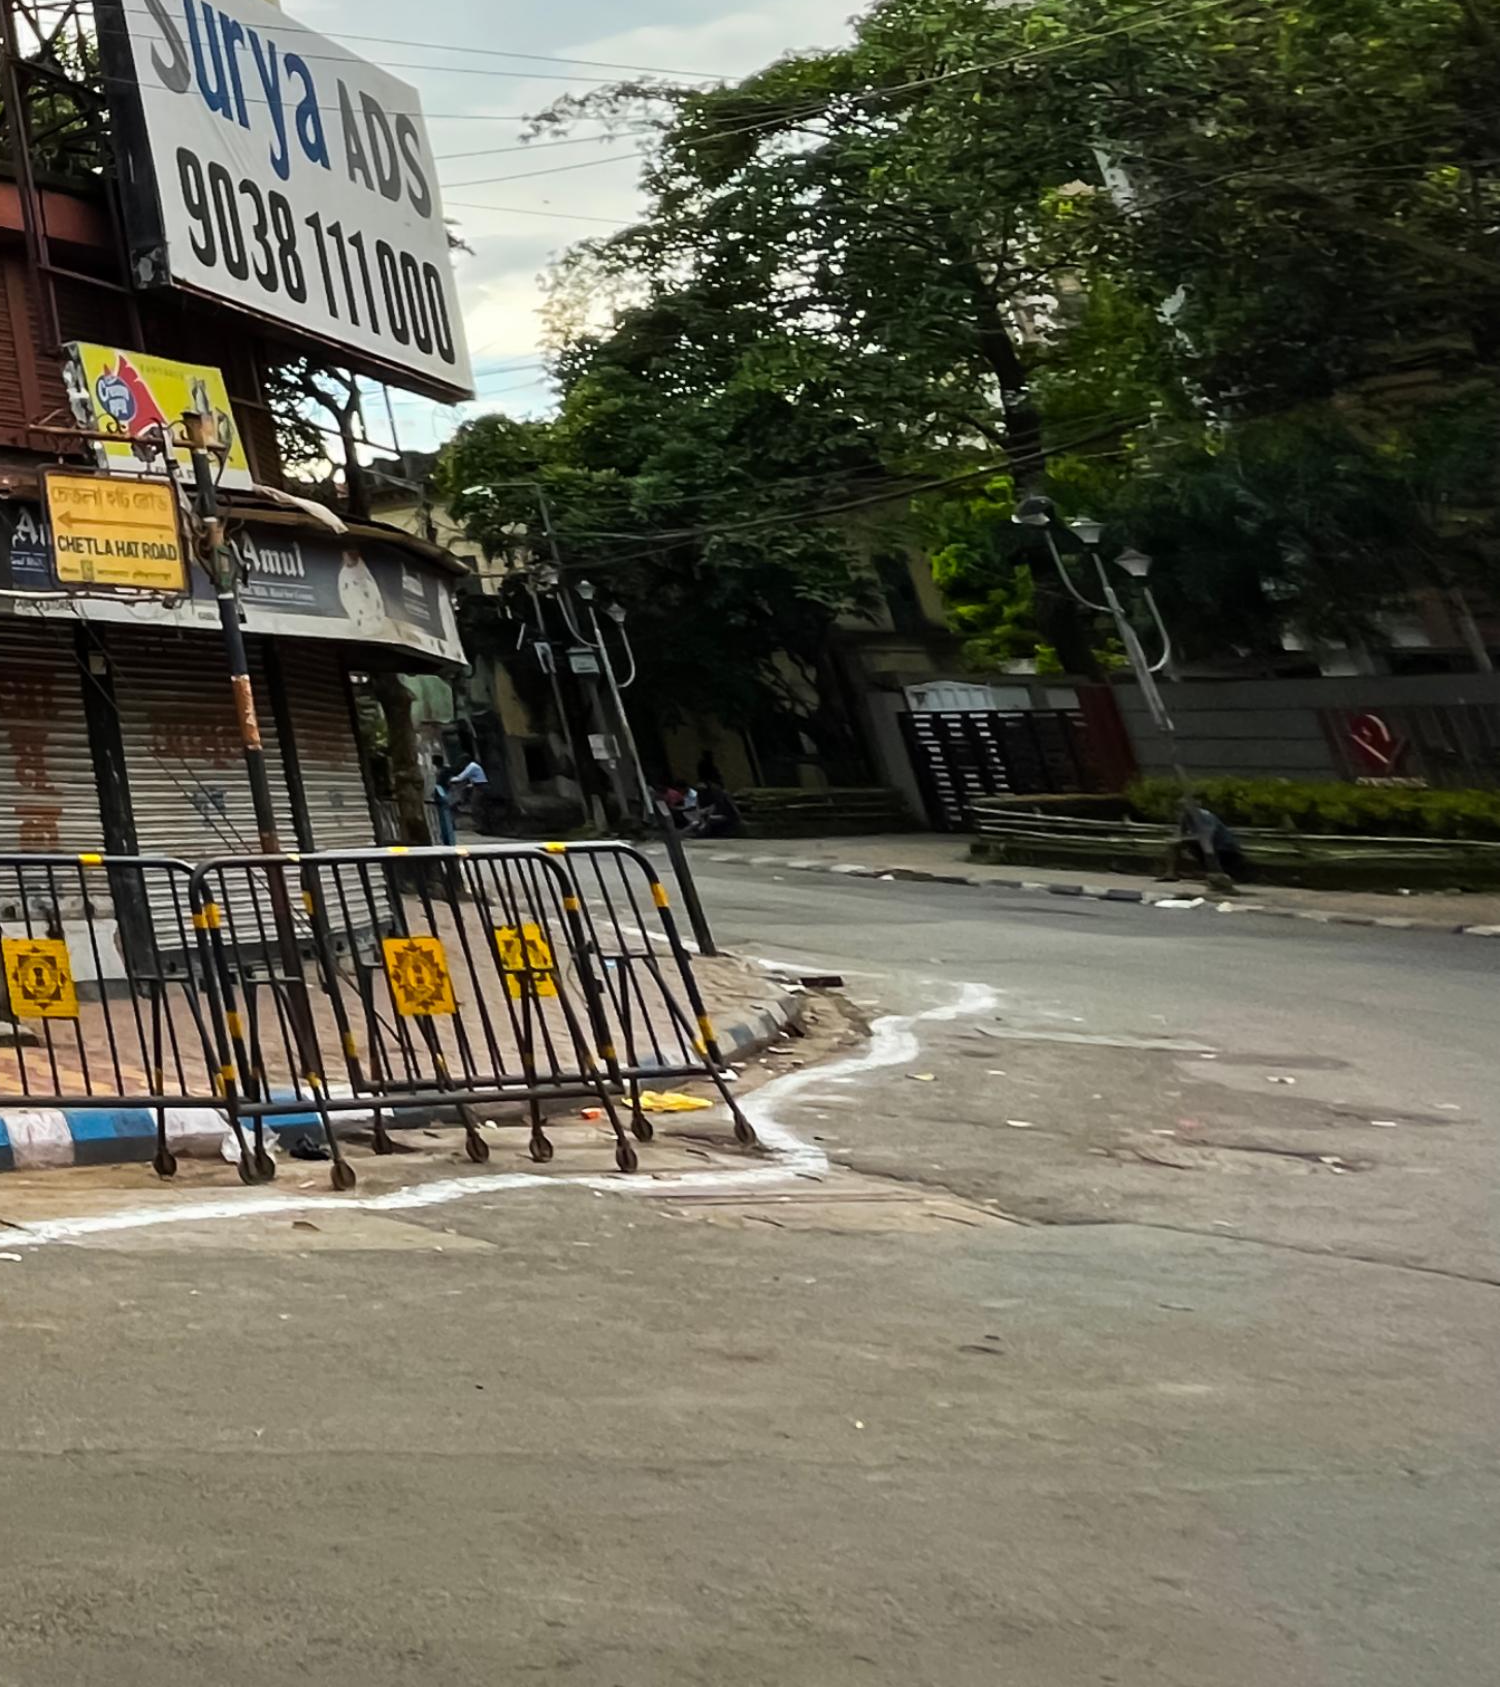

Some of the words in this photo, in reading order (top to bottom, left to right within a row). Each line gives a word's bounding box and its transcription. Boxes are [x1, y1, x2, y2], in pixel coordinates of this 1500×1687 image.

[336, 77, 432, 220] ADS
[57, 534, 115, 557] CHETLA
[115, 539, 141, 559] HAT
[141, 542, 178, 561] ROAD
[240, 530, 306, 579] Amul
